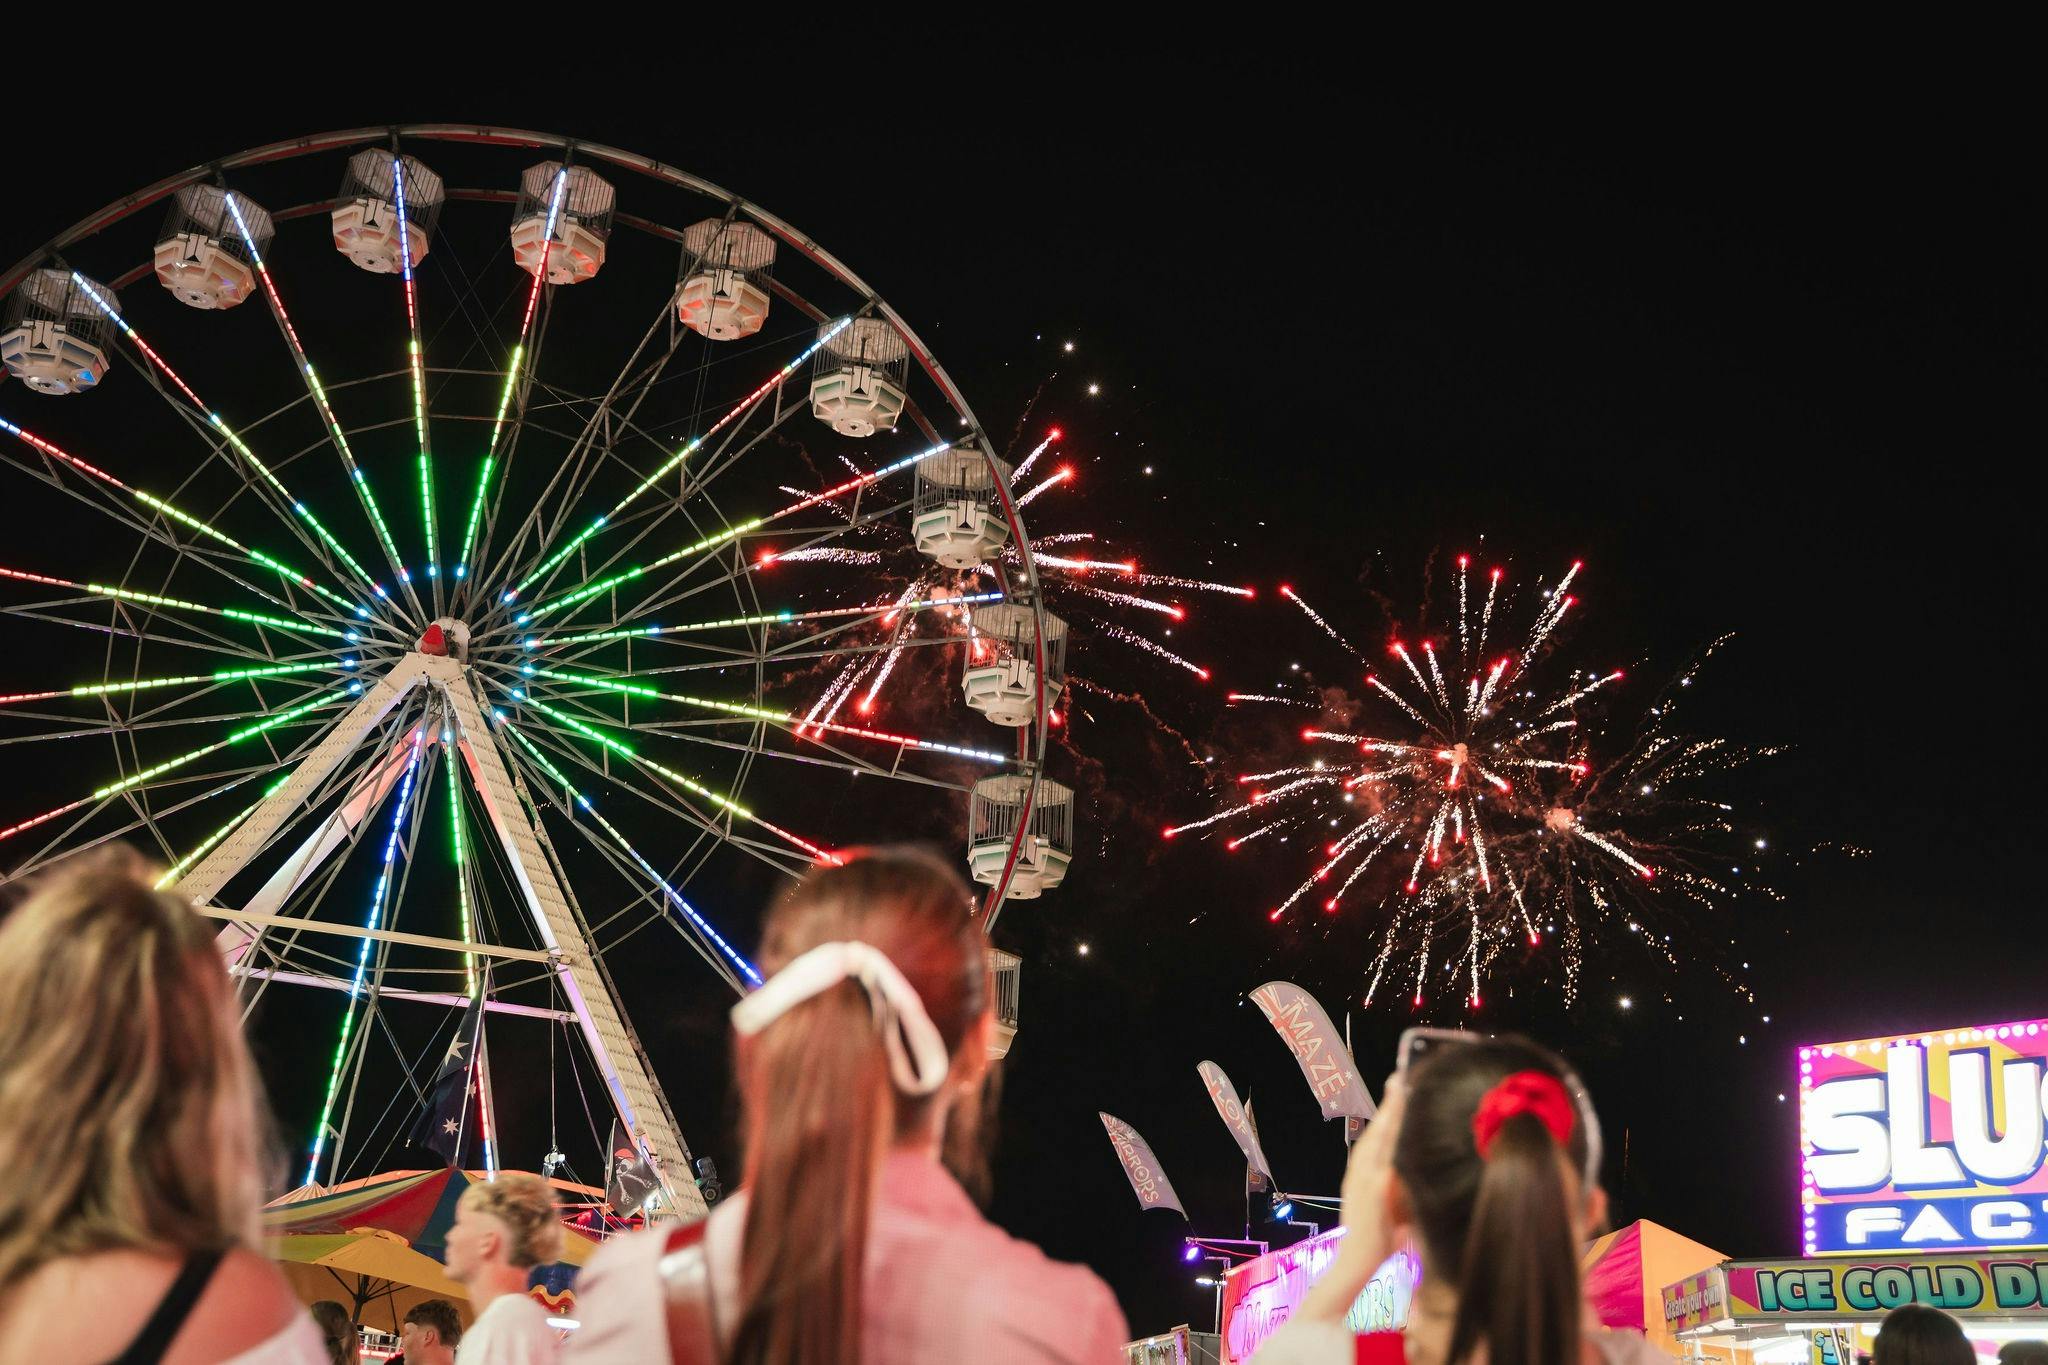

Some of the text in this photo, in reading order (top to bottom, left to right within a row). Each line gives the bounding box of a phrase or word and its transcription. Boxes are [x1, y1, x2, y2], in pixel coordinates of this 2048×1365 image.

[1281, 1003, 1346, 1098] MAZE
[1807, 1045, 2048, 1191] SLU
[1845, 1200, 2048, 1244] FAC
[1756, 1269, 1837, 1312] ICE
[1842, 1265, 1983, 1311] COLD
